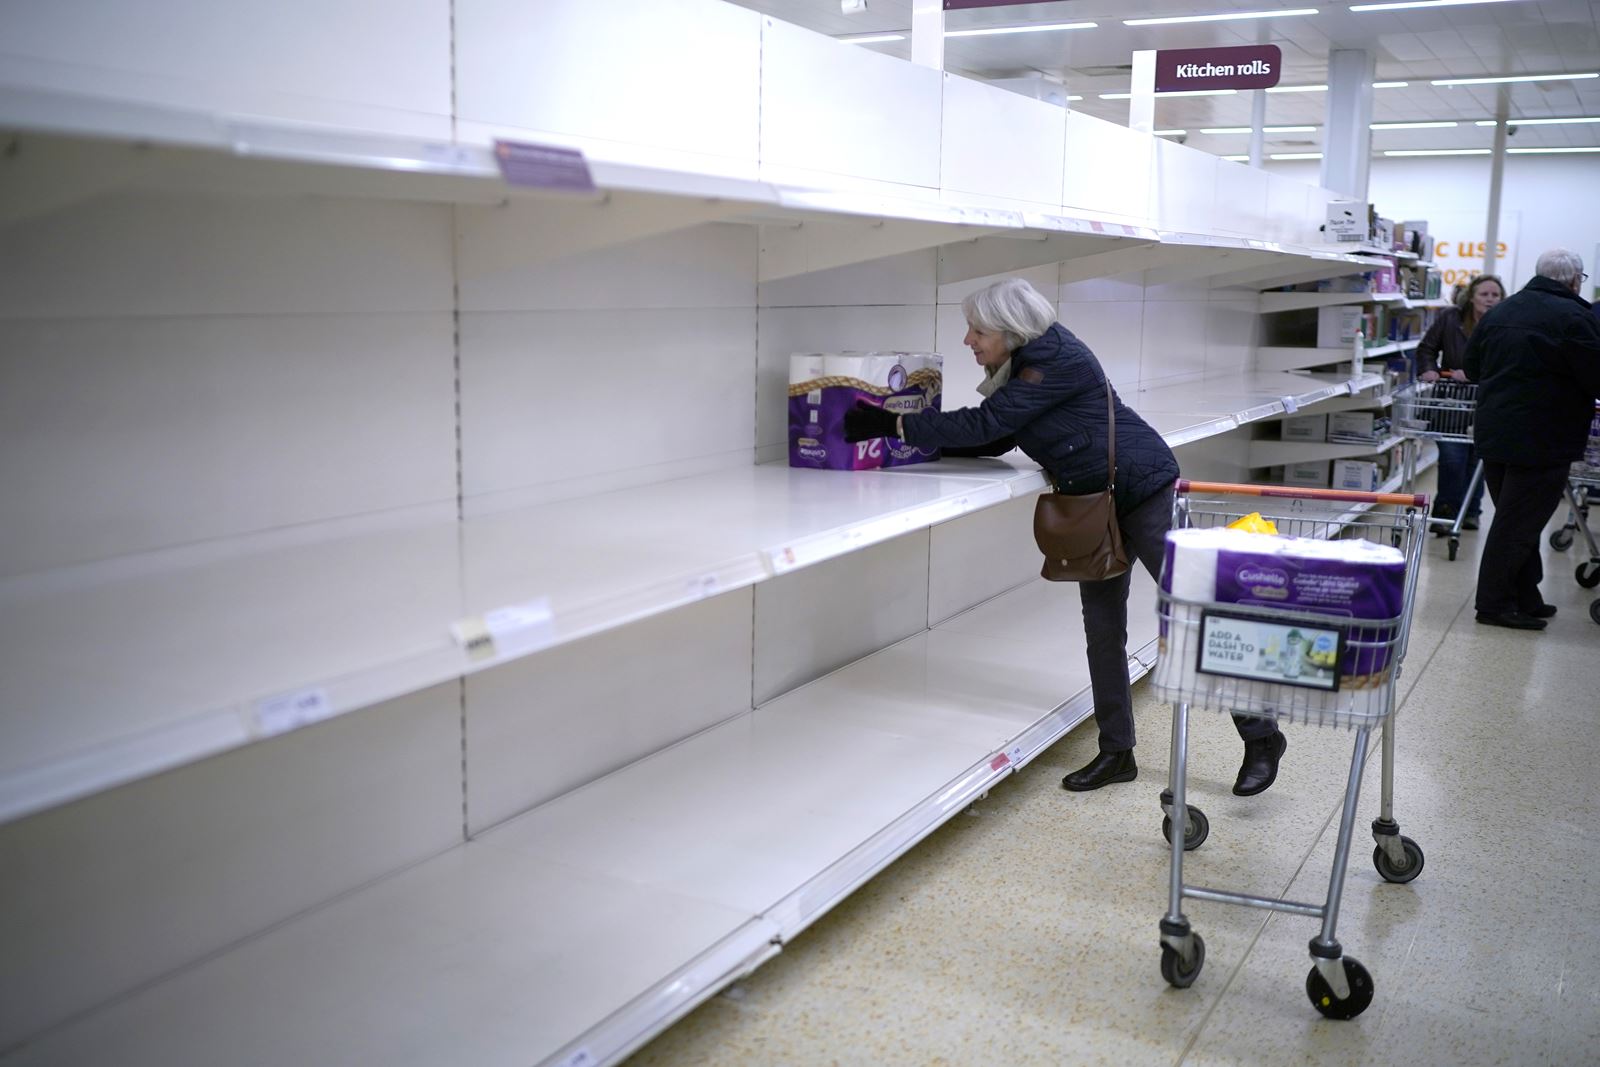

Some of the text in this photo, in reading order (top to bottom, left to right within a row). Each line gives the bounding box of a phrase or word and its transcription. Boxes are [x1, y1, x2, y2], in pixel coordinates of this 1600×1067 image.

[1176, 60, 1271, 78] Kitchen rolls
[1457, 241, 1508, 258] use
[903, 398, 924, 410] Ultra
[856, 437, 881, 460] 24
[1238, 569, 1286, 586] Cushelle
[1209, 630, 1242, 641] ADD A
[1209, 640, 1255, 653] DASH TO
[1208, 650, 1244, 662] WATER
